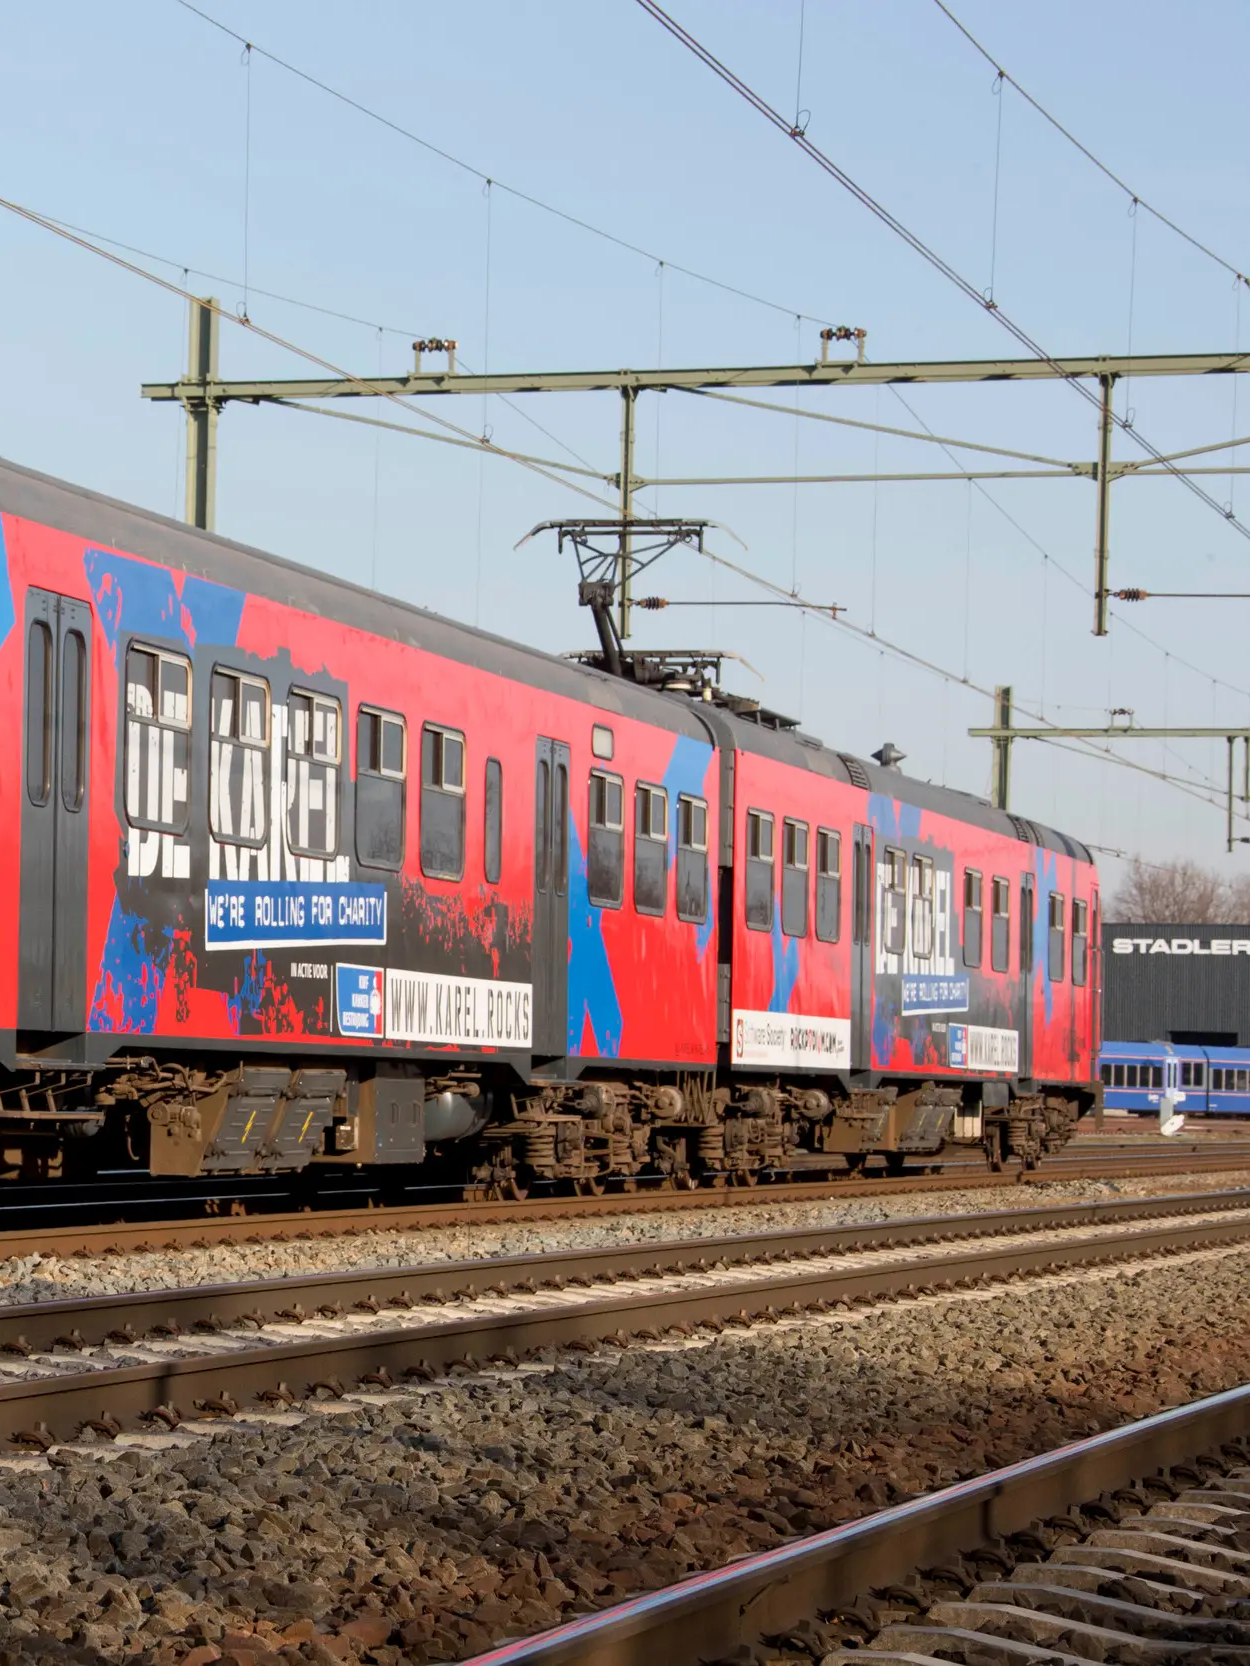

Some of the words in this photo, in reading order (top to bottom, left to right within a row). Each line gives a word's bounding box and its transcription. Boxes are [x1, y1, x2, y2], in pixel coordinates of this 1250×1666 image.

[127, 682, 191, 879] DE
[208, 697, 350, 883] KAREL
[209, 894, 245, 929] WE'RE
[255, 896, 305, 928] ROLLING
[311, 895, 333, 926] FOR
[338, 896, 382, 926] CHARITY
[875, 862, 898, 975] DE
[291, 962, 298, 977] IN
[313, 964, 328, 979] VOOR
[1112, 938, 1250, 955] STADLER
[391, 977, 530, 1041] WWW.KAREL.ROCKS
